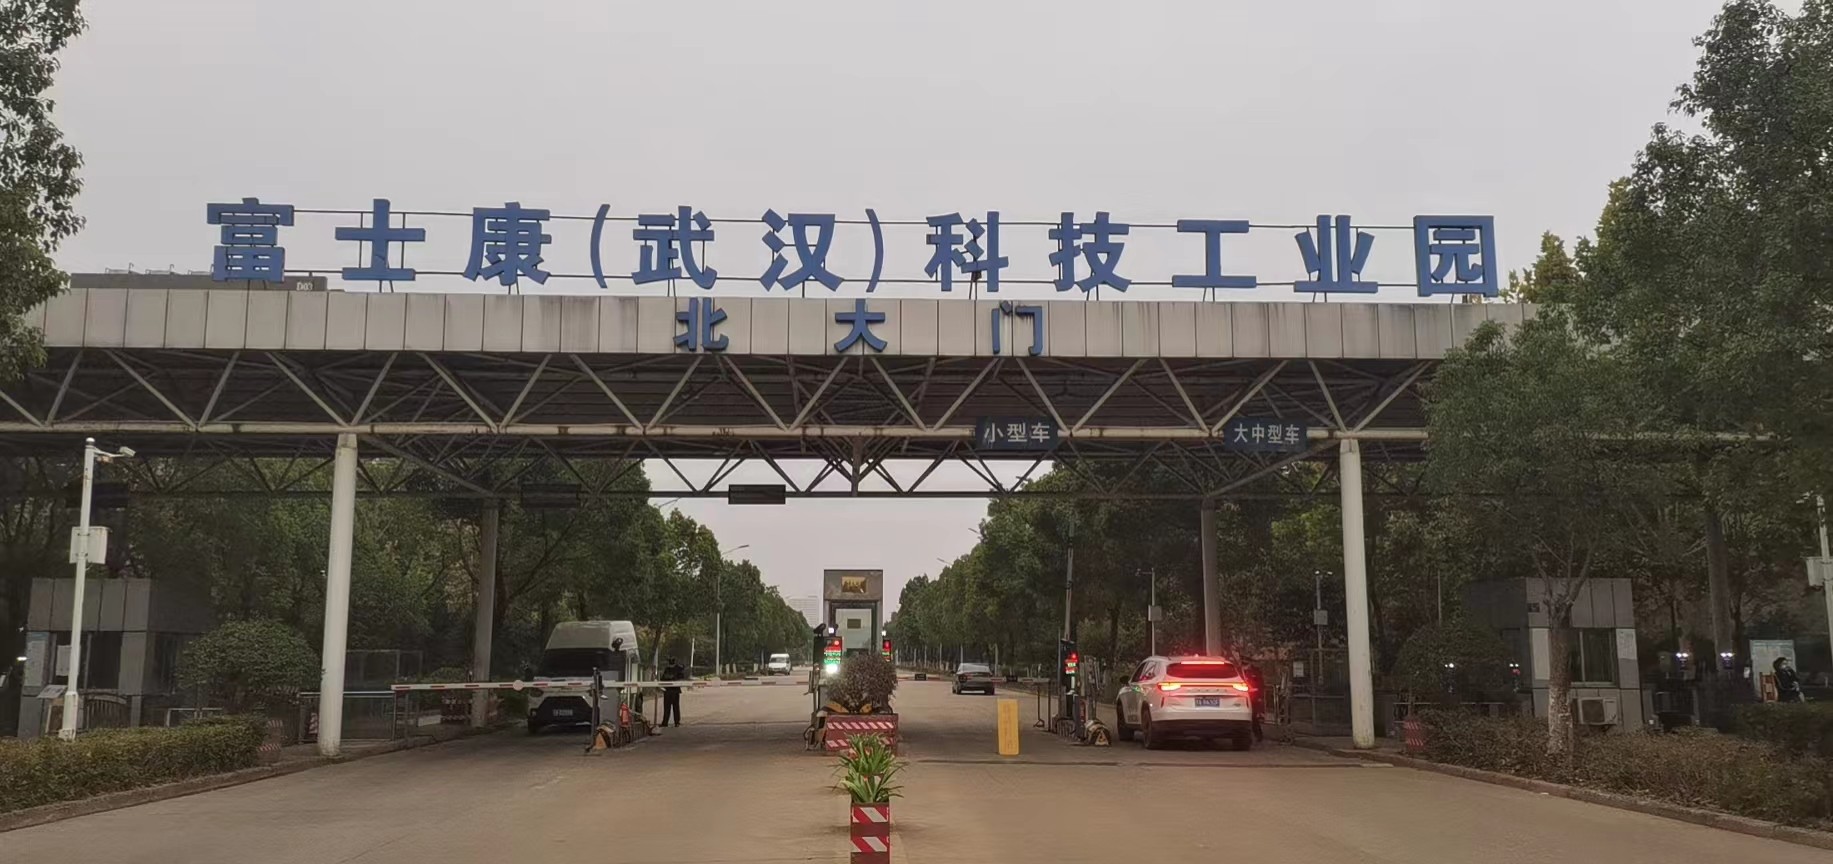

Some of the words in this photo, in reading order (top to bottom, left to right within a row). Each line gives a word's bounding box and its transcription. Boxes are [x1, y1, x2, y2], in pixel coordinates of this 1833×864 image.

[673, 297, 1043, 355] 北大门
[983, 421, 1050, 443] 小型车
[1233, 422, 1300, 444] 大中型车
